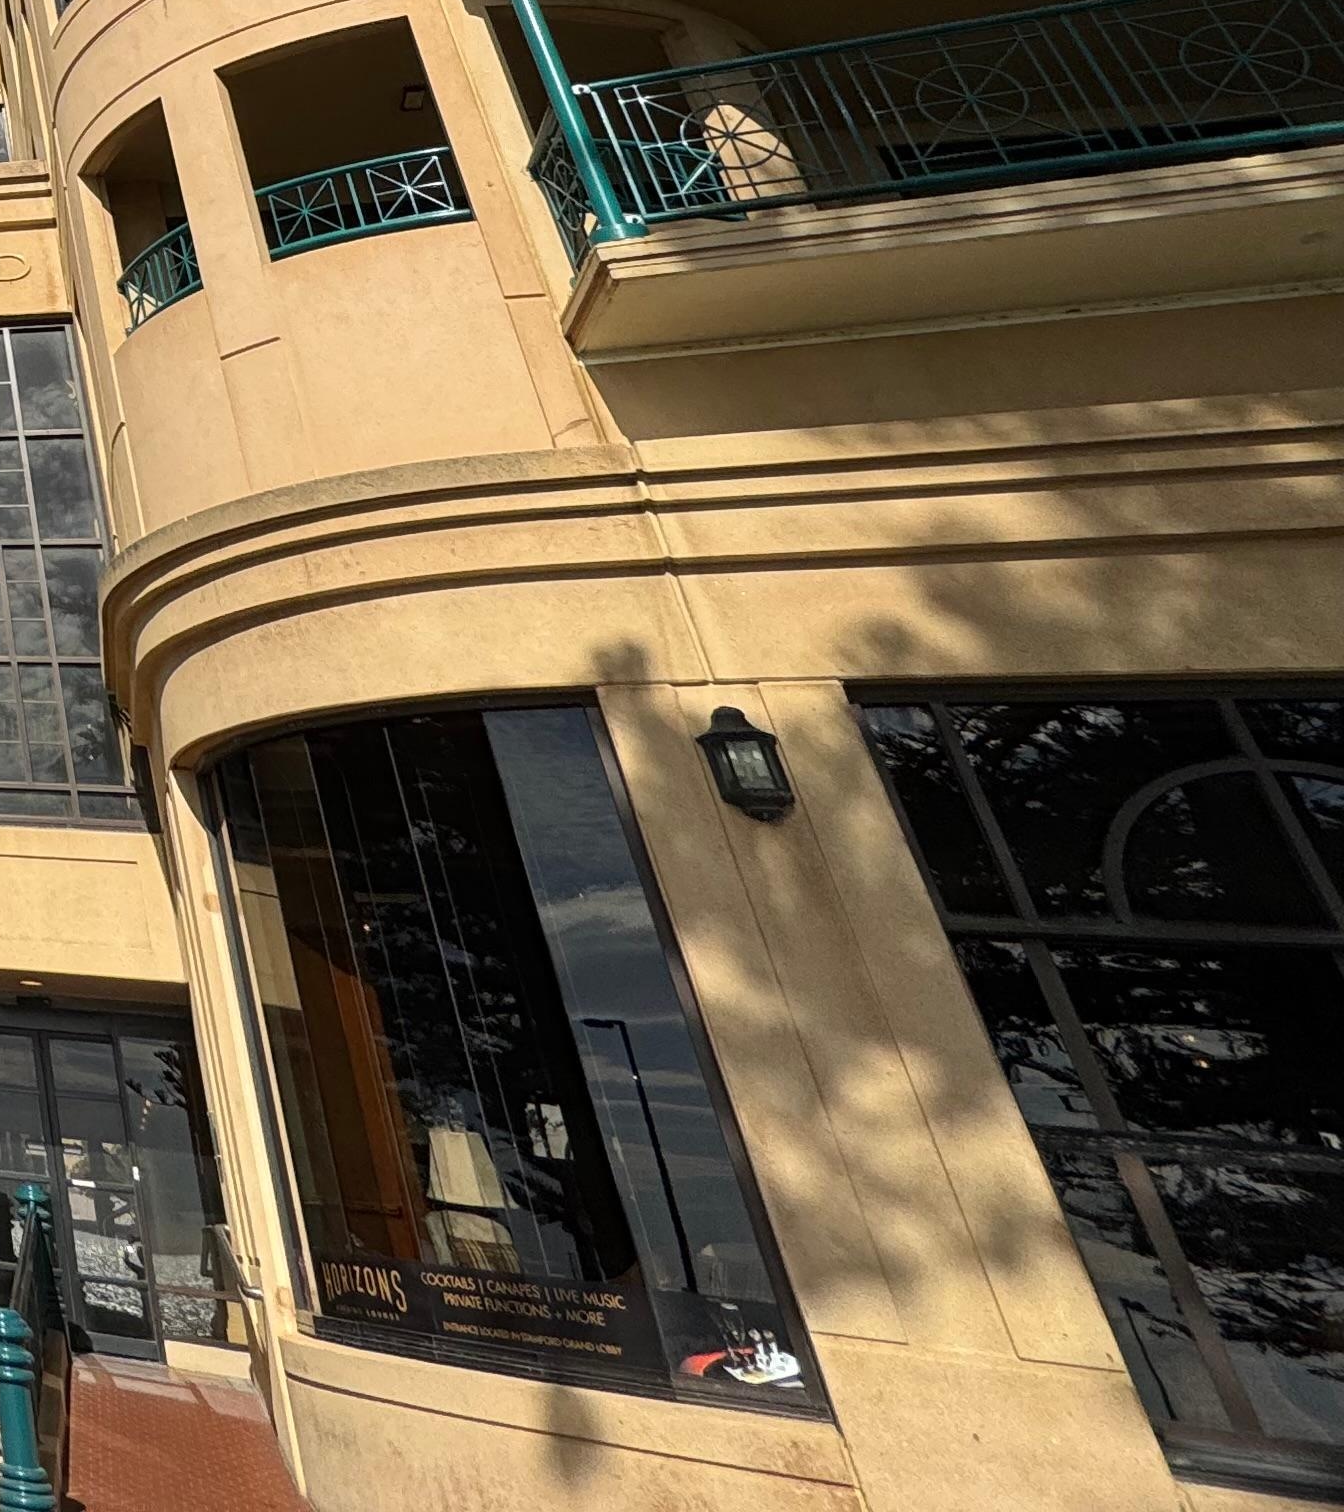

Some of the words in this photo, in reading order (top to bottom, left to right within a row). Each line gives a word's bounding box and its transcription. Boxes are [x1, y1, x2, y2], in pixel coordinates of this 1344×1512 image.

[320, 1261, 408, 1313] HORIZONS
[420, 1272, 476, 1290] COCKTAILS
[485, 1279, 541, 1299] CANAPES
[553, 1287, 580, 1304] LIVE
[582, 1291, 627, 1310] MUSIC
[442, 1291, 483, 1311] PRIVATE
[483, 1296, 552, 1320] FUNCTIONS
[565, 1309, 607, 1327] MORE
[595, 1343, 623, 1356] LOBBY
